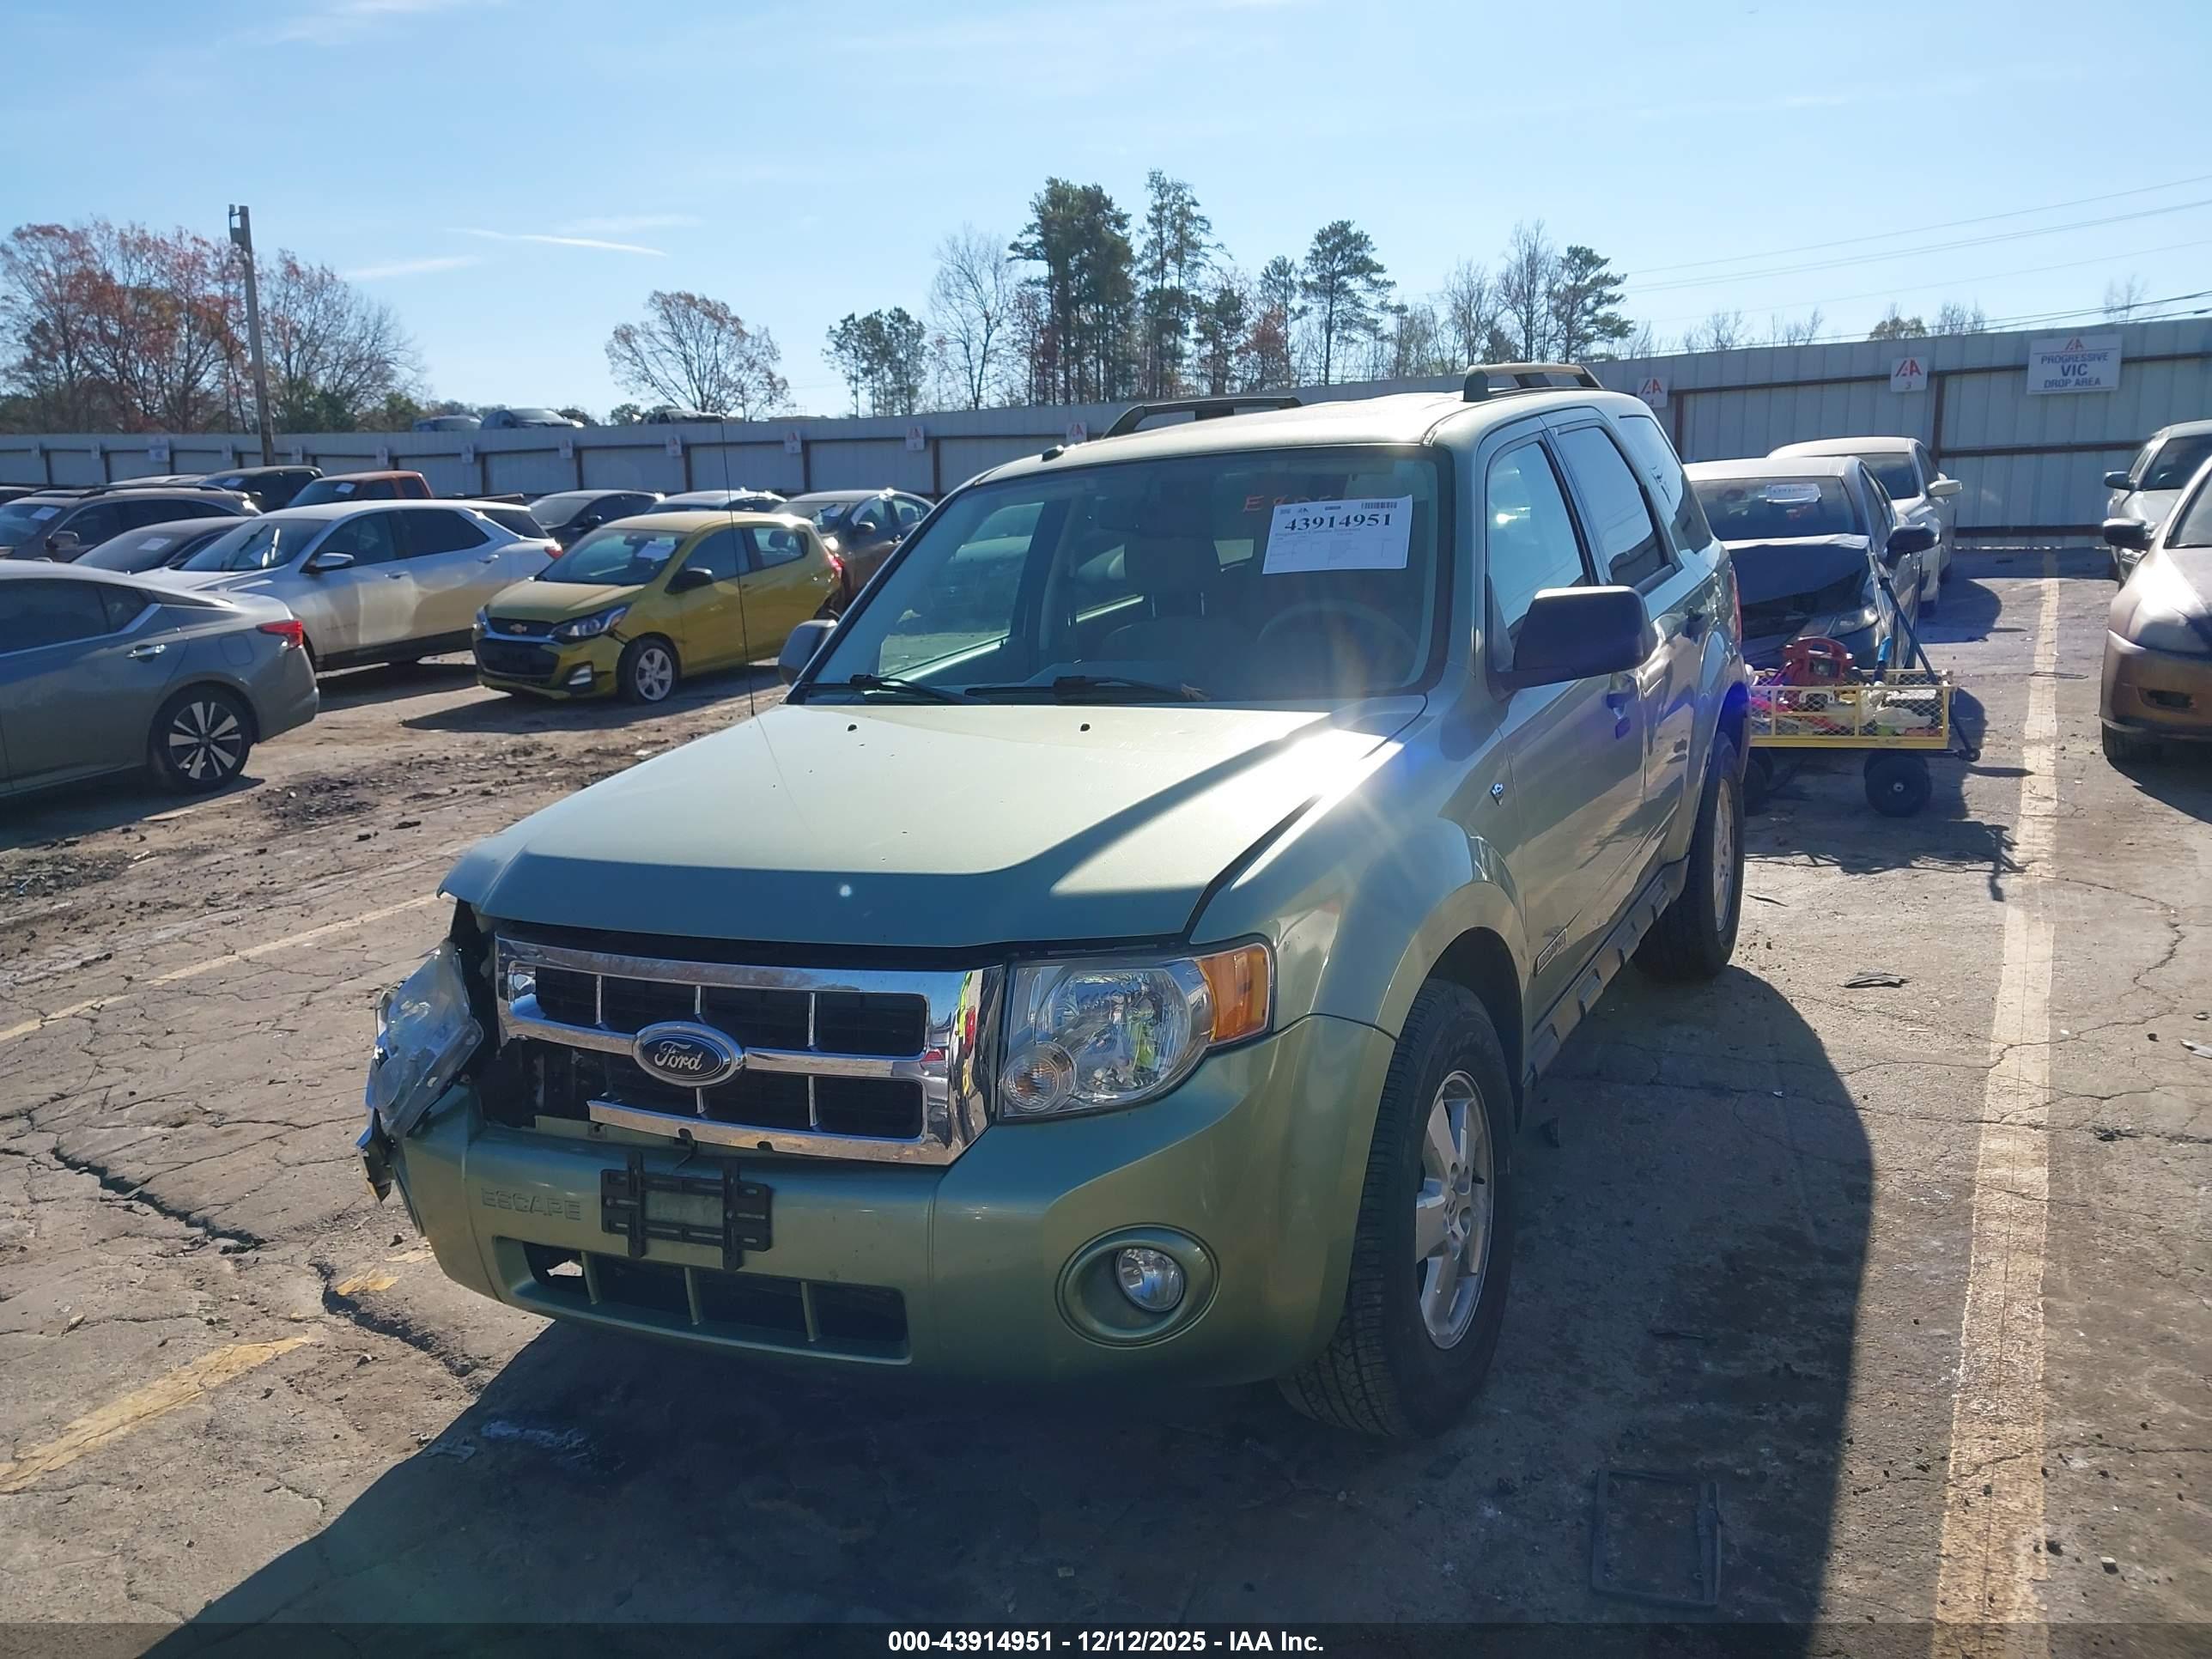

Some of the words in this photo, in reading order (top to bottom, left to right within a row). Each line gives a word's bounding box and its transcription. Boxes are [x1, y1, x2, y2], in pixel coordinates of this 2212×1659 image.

[2041, 352, 2109, 364] PROGRESSIVE
[2061, 363, 2088, 376] VIC
[2044, 379, 2071, 388] DROP
[2074, 377, 2100, 386] AREA
[1285, 514, 1390, 532] 43914951
[654, 1040, 703, 1072] Ford
[481, 1187, 581, 1220] ESCAPE
